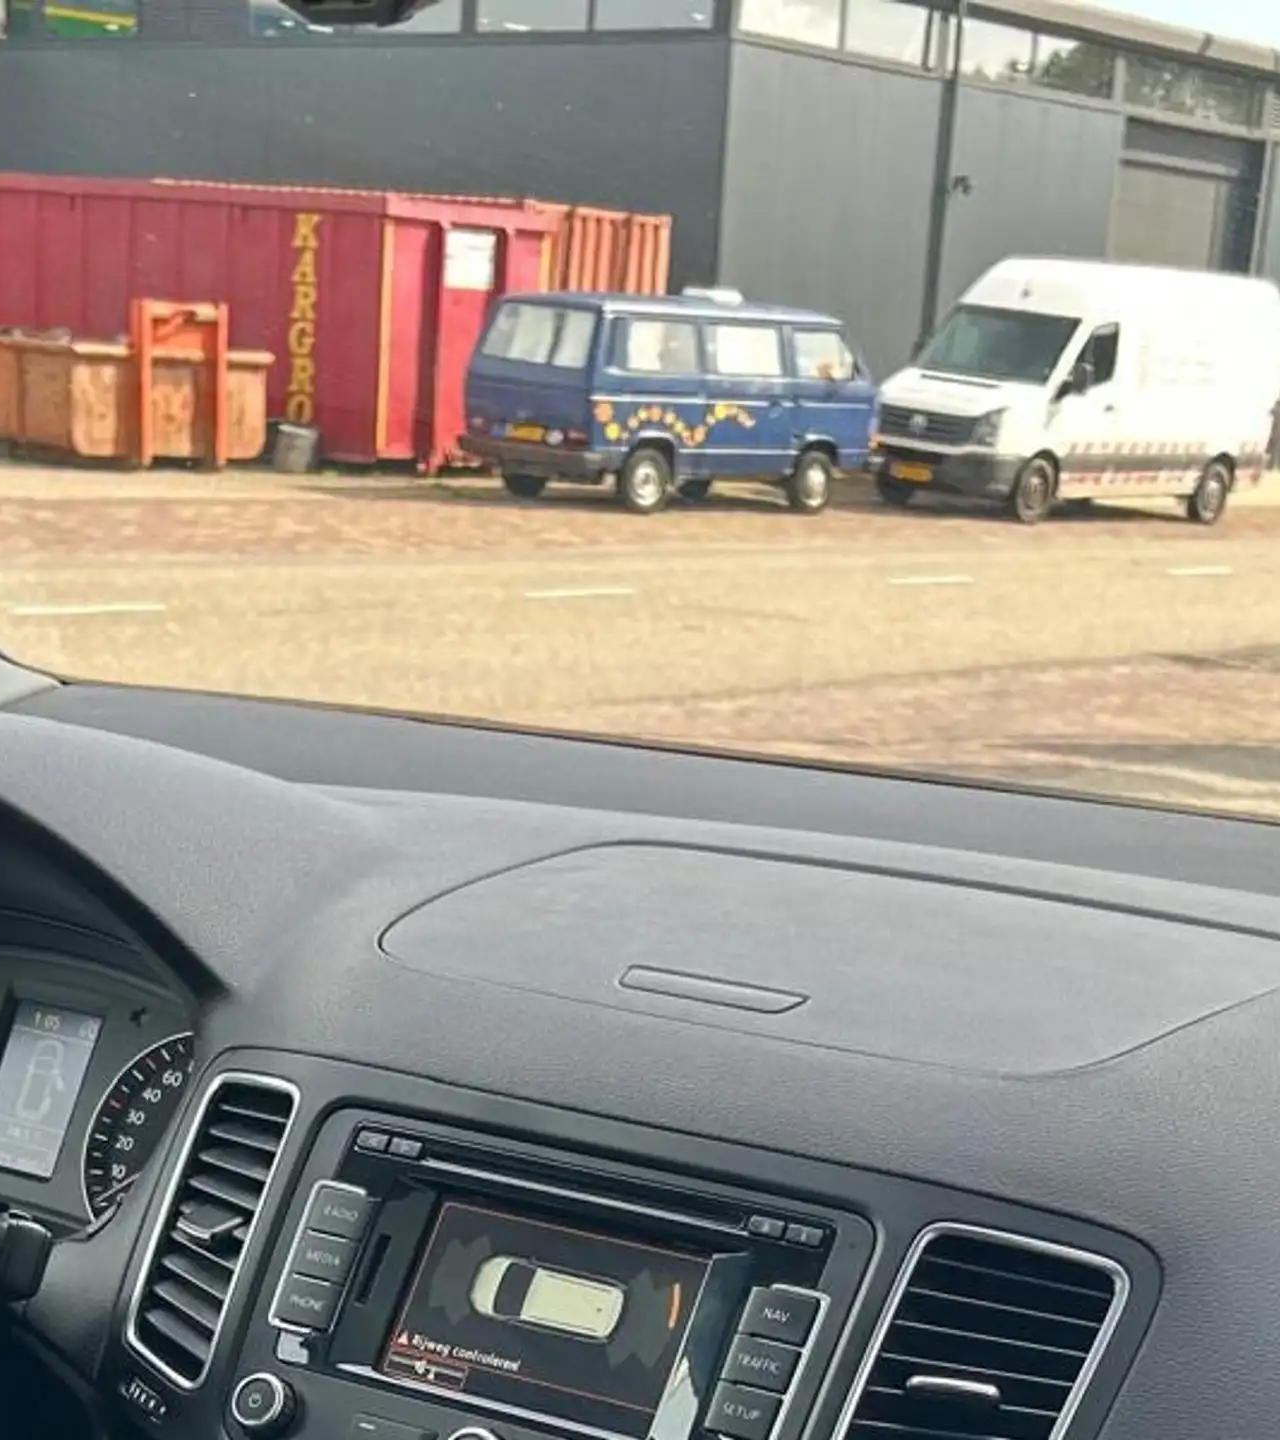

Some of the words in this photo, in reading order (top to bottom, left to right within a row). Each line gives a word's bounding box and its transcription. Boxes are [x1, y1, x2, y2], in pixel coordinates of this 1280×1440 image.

[286, 213, 320, 424] KARGRO
[162, 1068, 184, 1088] 60
[142, 1087, 162, 1104] 40
[126, 1107, 146, 1126] 30
[115, 1134, 135, 1151] 20
[111, 1163, 127, 1180] 10
[762, 1306, 791, 1324] NAV
[722, 1401, 762, 1420] SETUP
